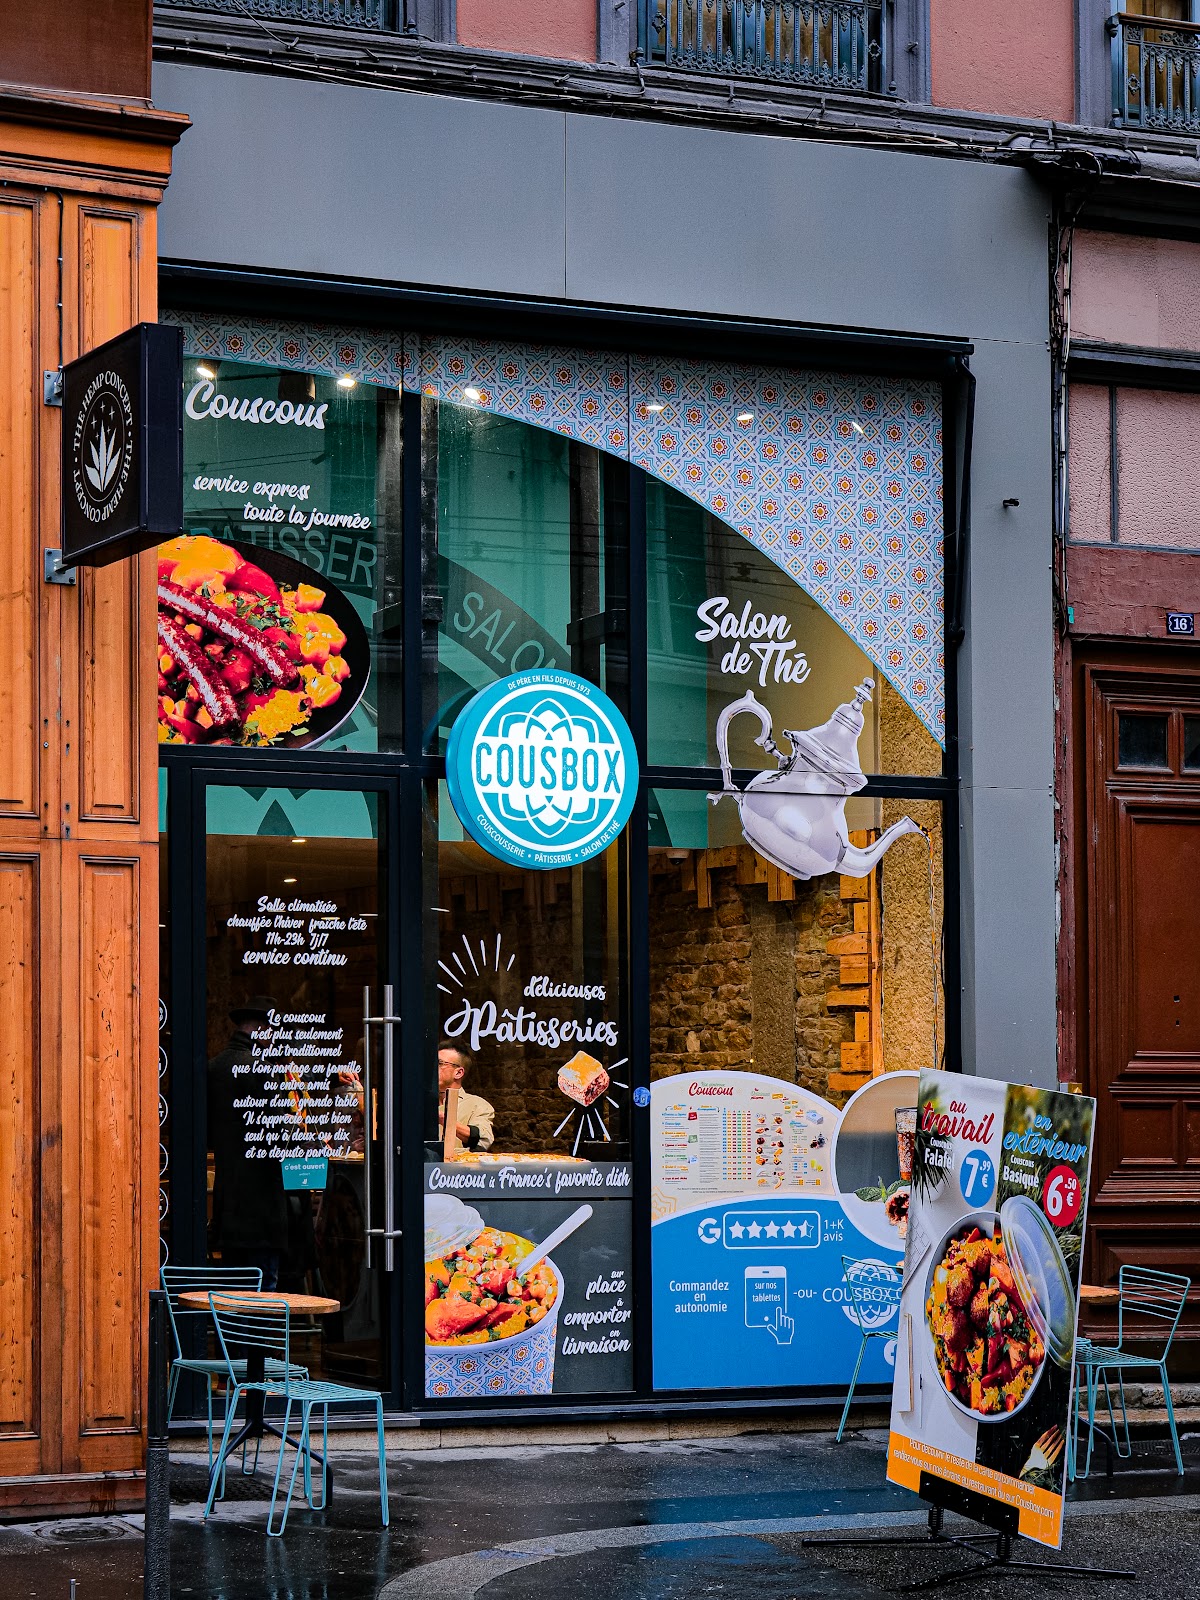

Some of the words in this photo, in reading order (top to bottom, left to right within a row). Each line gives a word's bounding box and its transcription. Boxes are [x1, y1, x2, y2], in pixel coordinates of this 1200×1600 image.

[74, 411, 86, 451] THE
[82, 373, 104, 411] HEMP
[105, 371, 133, 427] CONCEPT
[185, 380, 328, 430] Couscous
[121, 439, 133, 483] THE
[73, 470, 100, 523] CONCEPT
[193, 475, 249, 494] service
[253, 481, 311, 502] express
[102, 485, 125, 521] HEMP
[244, 502, 285, 523] toute
[289, 505, 307, 525] la
[303, 508, 371, 531] journée
[695, 597, 792, 642] Salon
[1174, 618, 1187, 630] 16
[454, 592, 556, 673] SALO
[721, 642, 753, 674] de
[750, 639, 812, 687] Thé
[508, 682, 517, 690] DE
[517, 677, 532, 687] PÈRE
[555, 676, 577, 688] DEPUIS
[577, 684, 591, 696] 1973
[476, 743, 622, 794] COUSBOX
[477, 814, 525, 858] COUSCOUSSERIE
[535, 853, 573, 864] PÂTISSERIE
[581, 839, 603, 857] SALON
[602, 833, 611, 843] DE
[609, 820, 621, 835] THÉ
[258, 896, 286, 913] Salle
[288, 900, 338, 914] climatisée
[227, 914, 272, 932] chauffée
[274, 915, 305, 929] l'hiver
[308, 918, 346, 933] fraîche
[348, 917, 368, 931] l'été
[266, 932, 305, 946] 11h-23h
[310, 933, 330, 950] 7j/7
[242, 948, 291, 965] service
[294, 949, 348, 966] continu
[524, 976, 606, 1001] délicieuses
[267, 1009, 282, 1026] Le
[283, 1012, 326, 1023] couscous
[444, 998, 619, 1051] Pâtisseries
[251, 1027, 273, 1040] n'est
[272, 1027, 294, 1043] plus
[295, 1027, 343, 1040] seulement
[252, 1044, 262, 1057] le
[261, 1044, 284, 1061] plat
[285, 1044, 343, 1057] traditionnel
[232, 1064, 251, 1078] que
[252, 1061, 273, 1074] l'on
[271, 1063, 311, 1078] partage
[312, 1064, 325, 1074] en
[325, 1060, 362, 1078] famille
[264, 1082, 278, 1091] ou
[280, 1079, 305, 1091] entre
[307, 1079, 331, 1091] amis
[689, 1082, 734, 1096] Couscous
[233, 1096, 268, 1108] autour
[270, 1095, 296, 1108] d'une
[298, 1095, 333, 1112] grande
[335, 1094, 359, 1107] table
[950, 1100, 969, 1115] au
[243, 1111, 255, 1125] Il
[256, 1112, 304, 1129] s'apprécie
[305, 1113, 330, 1126] aussi
[331, 1111, 352, 1124] bien
[921, 1102, 995, 1145] travail
[1034, 1114, 1053, 1131] en
[244, 1130, 265, 1142] seul
[292, 1129, 316, 1142] deux
[318, 1133, 332, 1142] ou
[334, 1129, 350, 1141] dix
[930, 1137, 953, 1150] Couscous
[1003, 1127, 1088, 1163] extérieur
[245, 1148, 256, 1159] et
[256, 1150, 267, 1159] se
[269, 1147, 305, 1162] déguste
[305, 1148, 344, 1161] partout
[925, 1148, 955, 1170] Falafel
[1010, 1155, 1035, 1169] Couscous
[429, 1167, 487, 1190] Couscous
[498, 1166, 552, 1189] France's
[555, 1168, 604, 1194] favorite
[606, 1167, 631, 1188] dish
[1003, 1166, 1040, 1189] Basique
[824, 1219, 845, 1230] 1+K
[823, 1231, 844, 1242] avis
[611, 1270, 625, 1279] sur
[586, 1276, 627, 1300] place
[670, 1280, 729, 1292] Commandez
[694, 1293, 706, 1302] en
[752, 1293, 781, 1302] tablettes
[675, 1302, 727, 1313] autonomie
[564, 1307, 632, 1330] emporter
[610, 1330, 621, 1338] en
[562, 1337, 631, 1356] livraison
[910, 1439, 921, 1450] Pour
[966, 1462, 973, 1470] de
[924, 1462, 933, 1471] sur
[933, 1465, 943, 1474] nos
[962, 1476, 969, 1486] au
[969, 1479, 997, 1497] restaurant
[998, 1489, 1006, 1499] ou
[1006, 1494, 1015, 1503] sur
[1016, 1495, 1054, 1519] Cousbox.com
